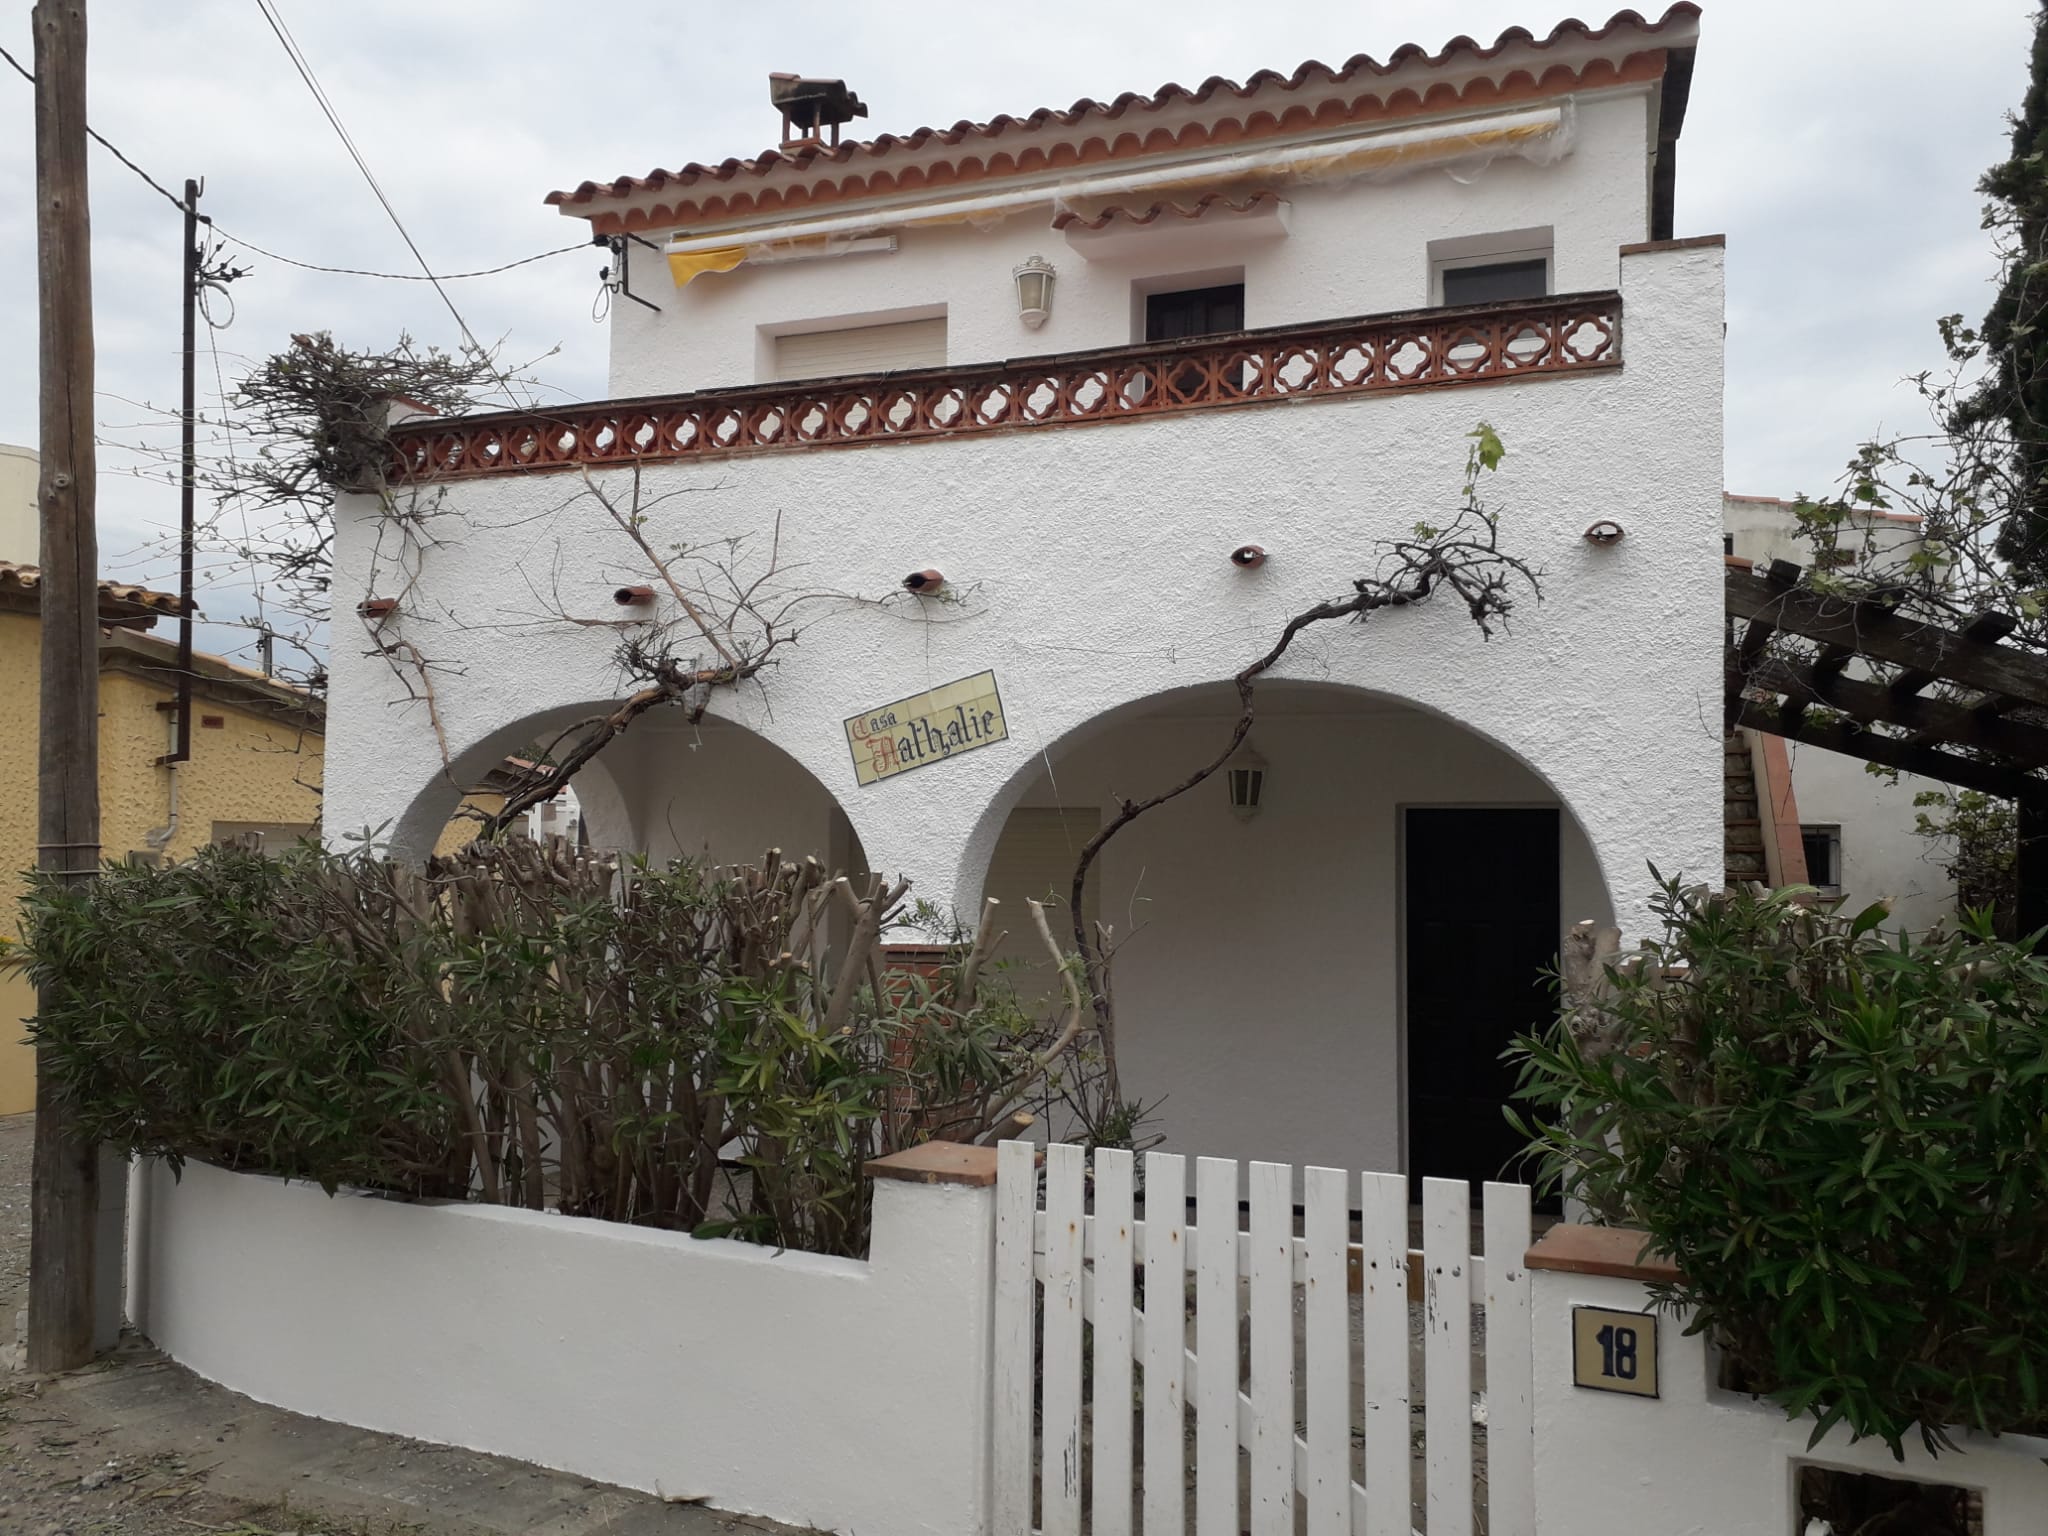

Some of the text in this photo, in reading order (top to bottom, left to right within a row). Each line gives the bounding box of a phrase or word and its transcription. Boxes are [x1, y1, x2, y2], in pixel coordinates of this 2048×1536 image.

[852, 711, 897, 741] Casa
[865, 704, 994, 773] Nathalie
[1595, 1324, 1637, 1380] 18
